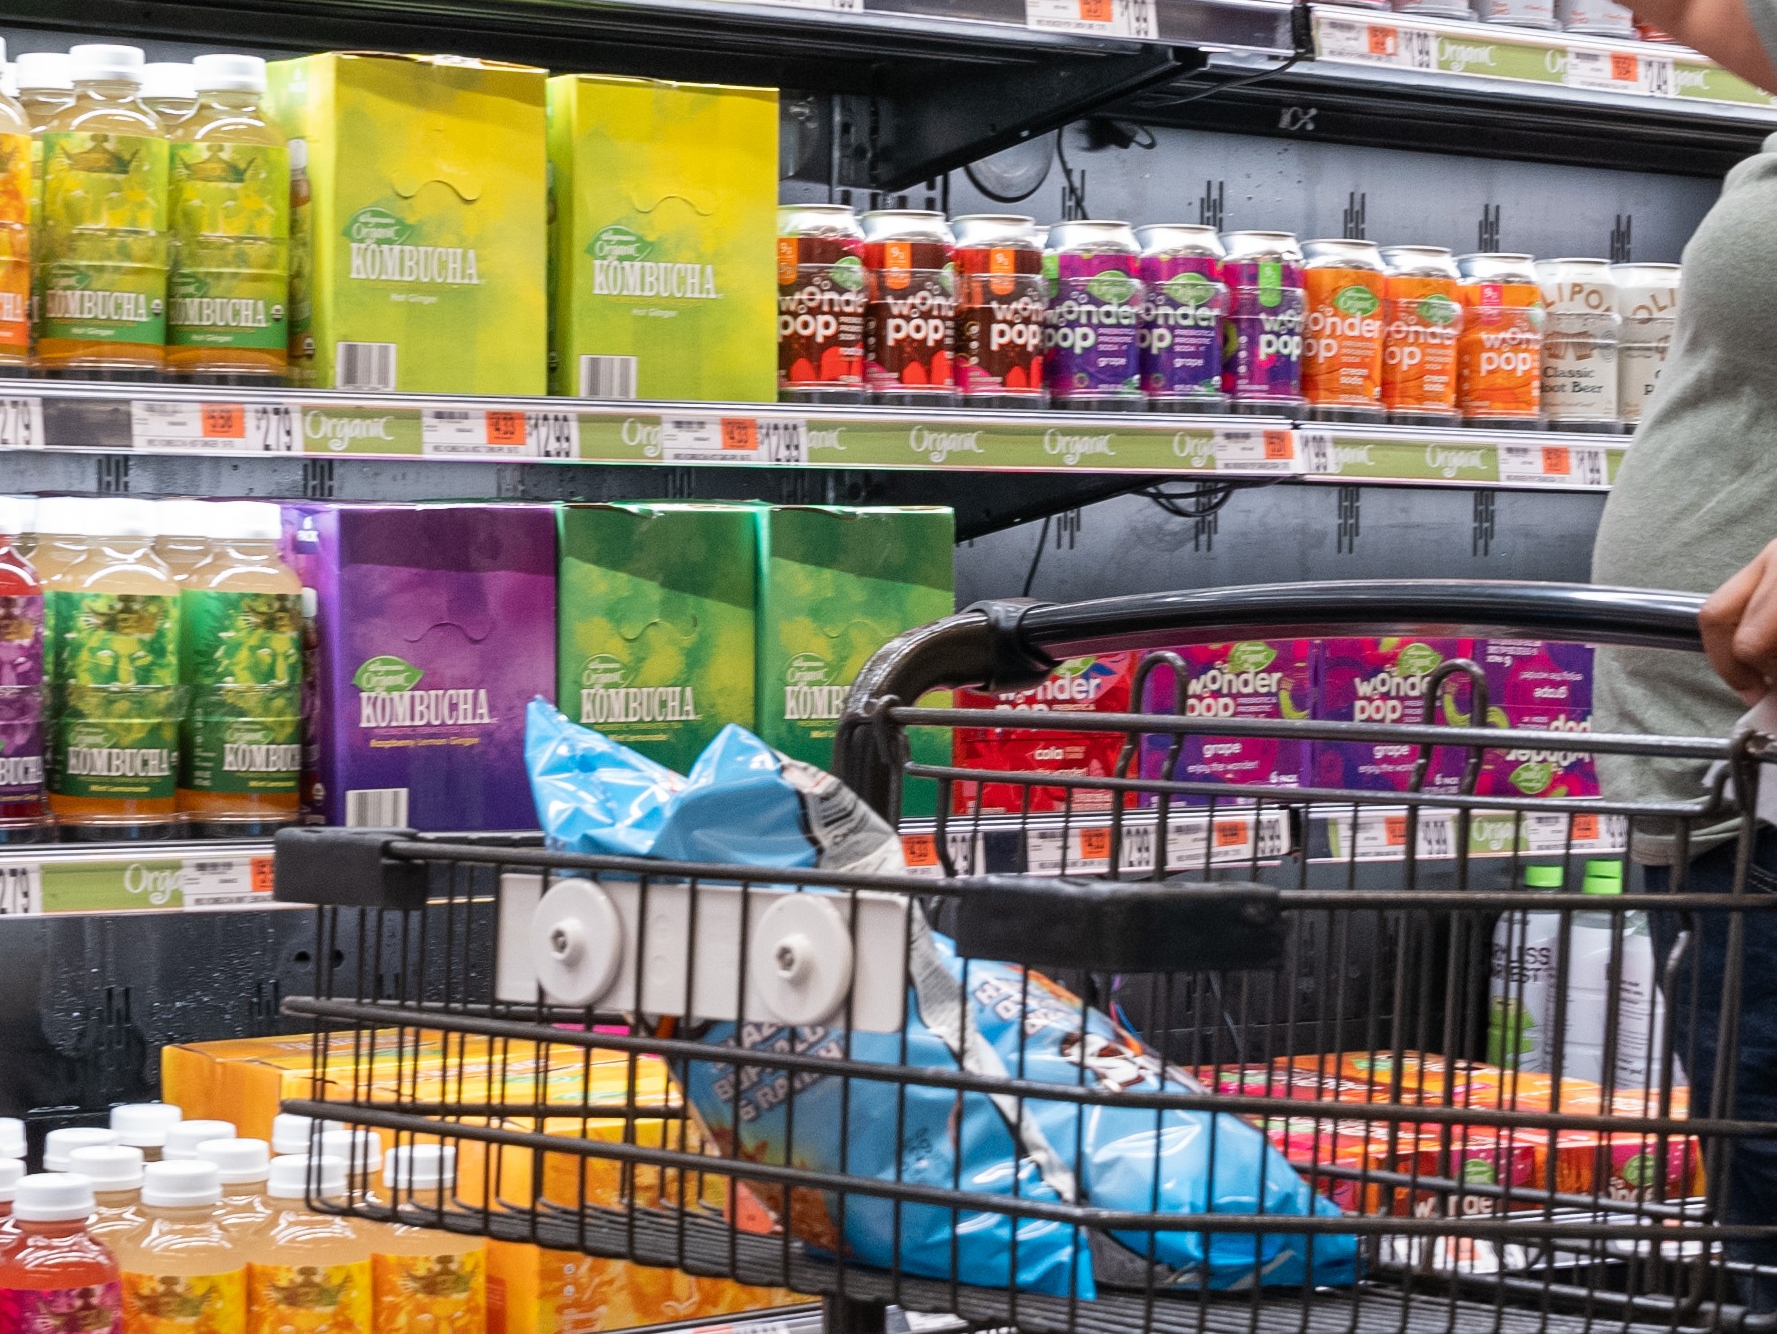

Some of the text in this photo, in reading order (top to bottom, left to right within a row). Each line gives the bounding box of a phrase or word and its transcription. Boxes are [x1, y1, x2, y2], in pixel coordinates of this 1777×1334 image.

[350, 245, 479, 285] KOMBUCHA
[593, 259, 716, 299] KOMBUCHA
[778, 312, 838, 343] pop
[888, 314, 947, 345] pop
[1479, 348, 1532, 375] pop
[1544, 367, 1595, 380] Classic
[1573, 381, 1602, 395] Beer
[306, 409, 394, 453] Organic
[909, 425, 985, 464] Organic
[1044, 427, 1114, 466] Organic
[1426, 444, 1488, 478] Organic
[1186, 670, 1282, 698] wonder
[359, 689, 490, 728] KOMBUCHA
[580, 686, 695, 722] KOMBUCHA
[1186, 695, 1235, 720] pop
[1354, 696, 1402, 722] pop
[68, 748, 170, 777] KOMBUCHA
[1202, 742, 1241, 758] grape
[1373, 743, 1410, 759] grape
